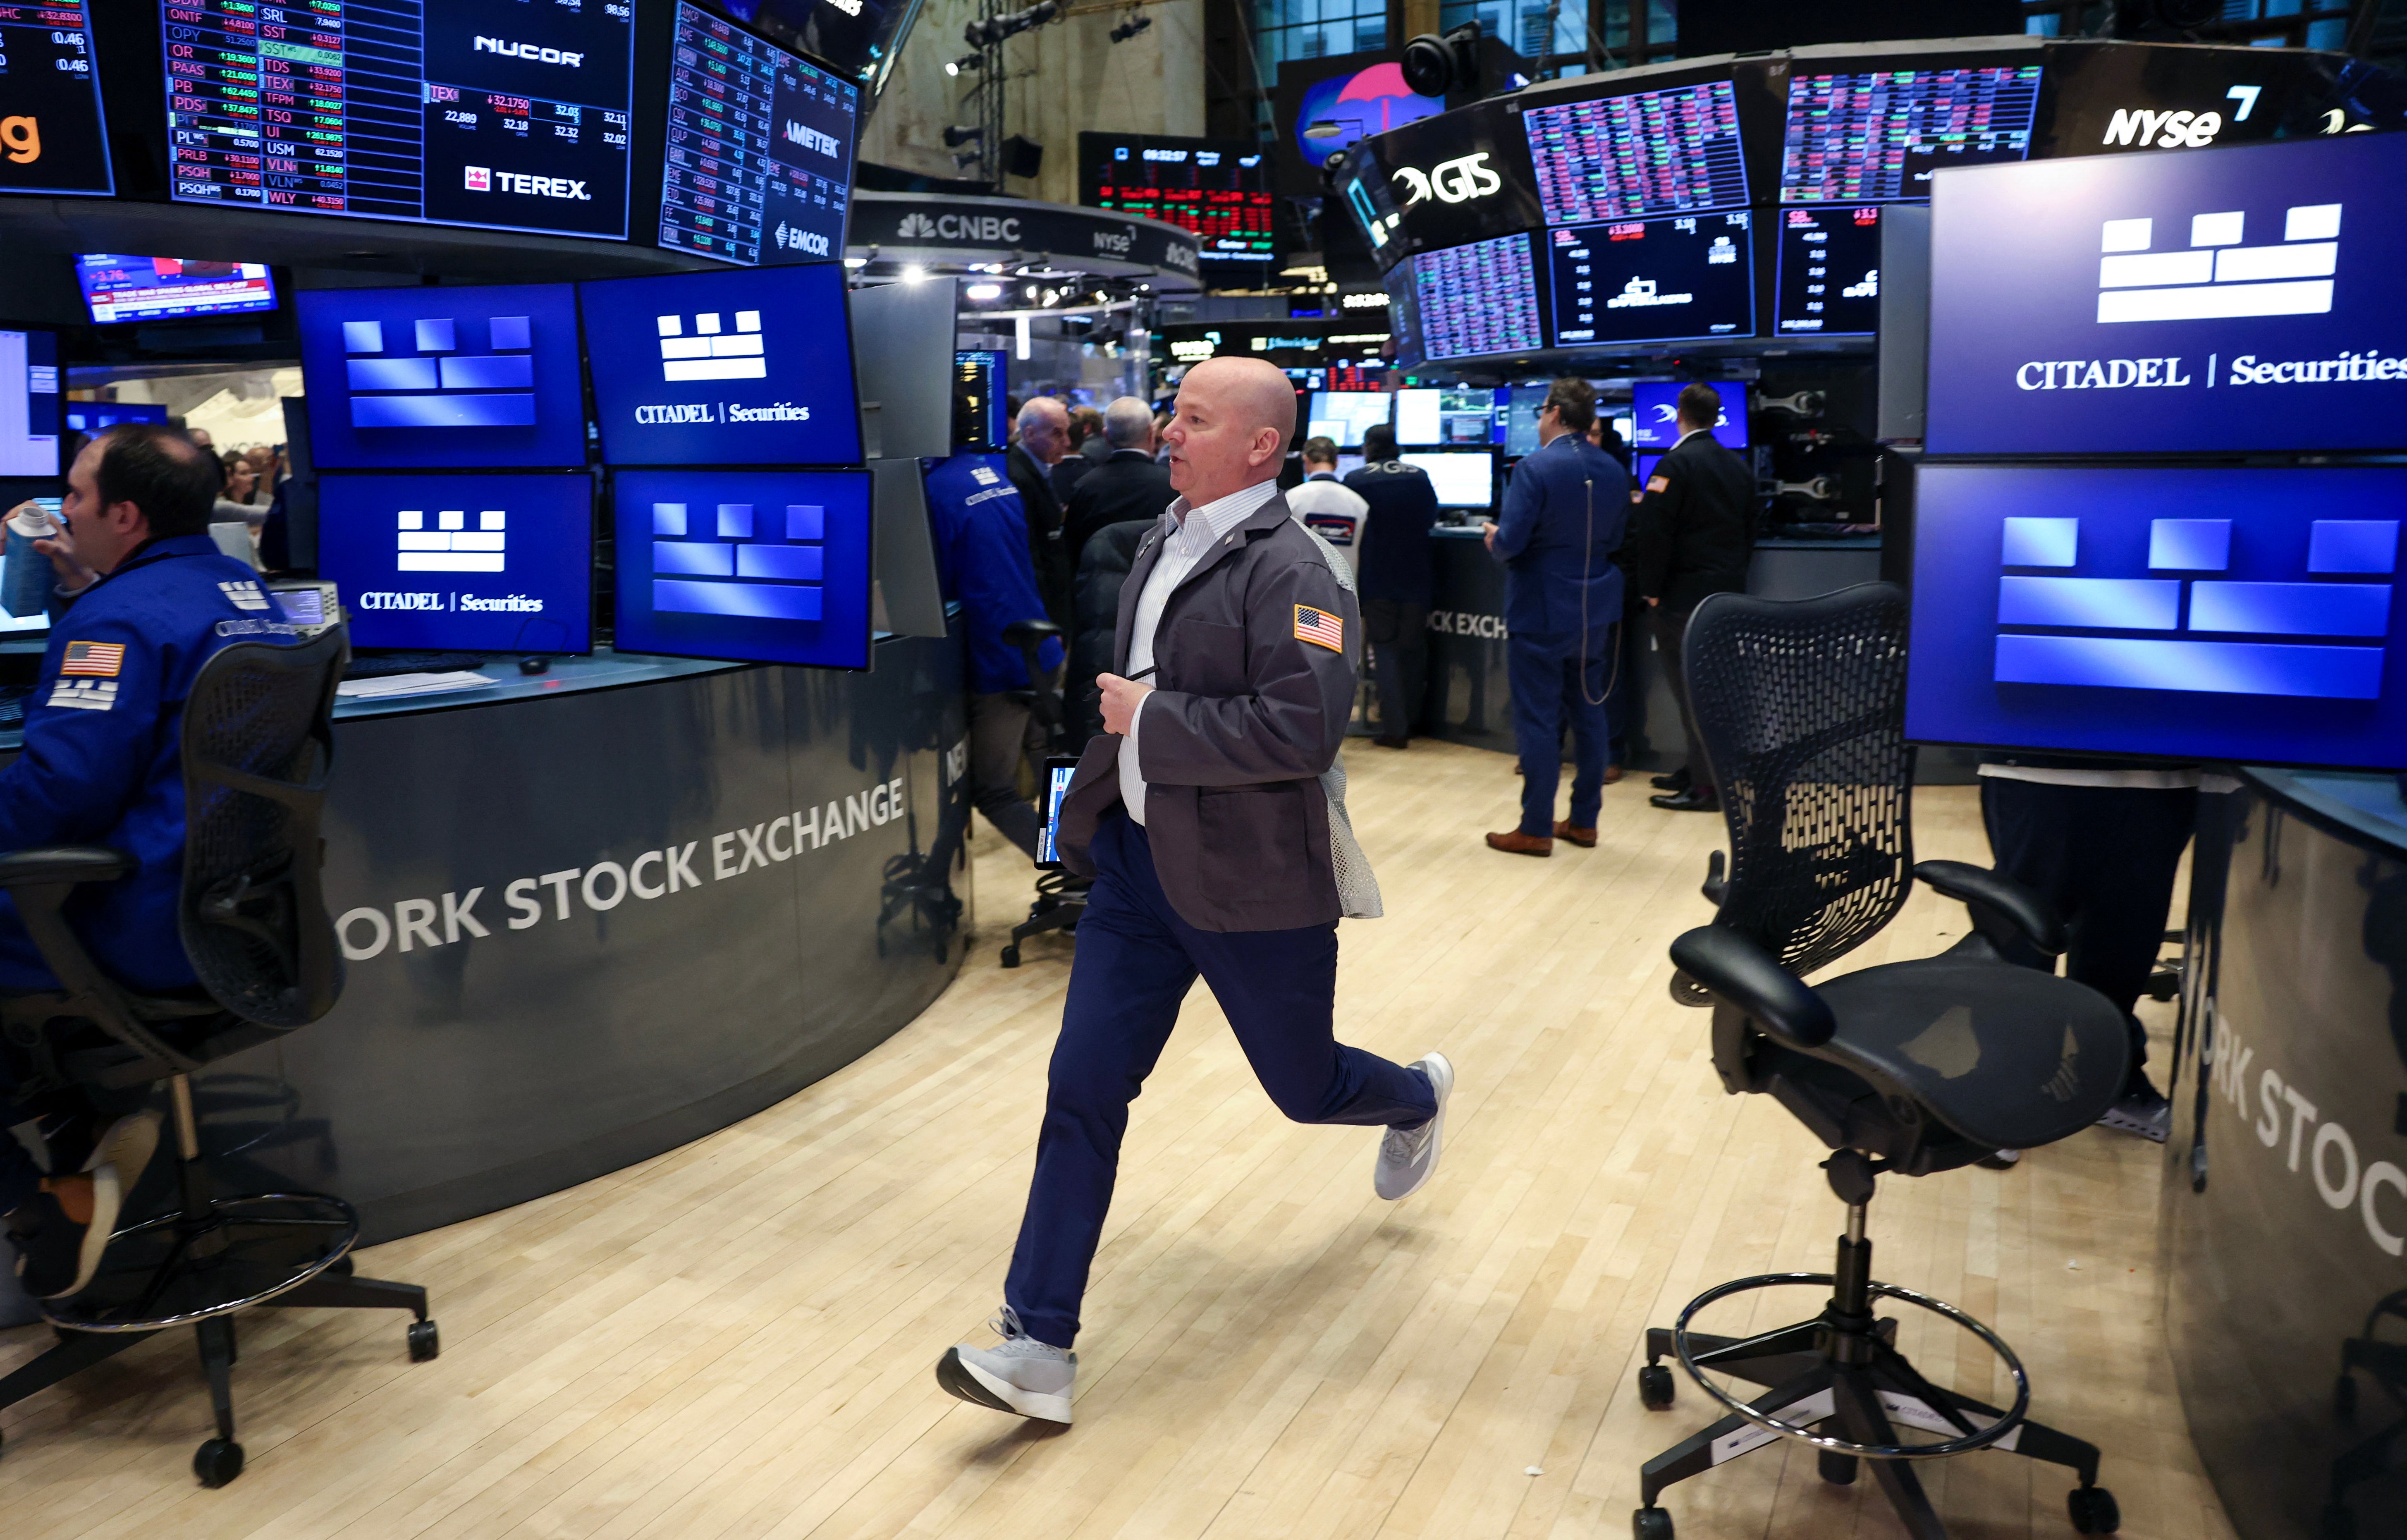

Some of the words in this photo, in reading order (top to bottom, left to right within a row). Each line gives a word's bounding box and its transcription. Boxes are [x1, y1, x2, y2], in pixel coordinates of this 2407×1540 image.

[169, 9, 202, 22] ONTF
[261, 8, 287, 23] SRL
[52, 32, 84, 45] 0.46
[172, 27, 201, 41] OPY
[262, 25, 287, 39] SST
[317, 34, 341, 44] 0.3127
[171, 45, 193, 58] OR
[474, 36, 581, 67] NUCOR
[56, 59, 88, 72] 0.46
[173, 62, 204, 75] PAAS
[265, 59, 289, 73] TDS
[314, 67, 342, 77] 33.9200
[174, 79, 193, 92] PB
[265, 75, 289, 90] TEX
[314, 83, 342, 93] 32.1750
[175, 97, 202, 111] PDS
[265, 93, 294, 105] TFPM
[430, 85, 454, 100] TEX
[494, 95, 529, 109] 32.1750
[555, 105, 579, 117] 32.03
[604, 112, 626, 124] 32.11
[266, 109, 291, 123] TSQ
[267, 126, 280, 138] UI
[445, 110, 477, 124] 22,889
[504, 118, 528, 131] 32.18
[555, 125, 578, 138] 32.32
[603, 132, 626, 144] 32.02
[0, 115, 41, 163] g
[233, 139, 259, 148] 0.5700
[786, 119, 839, 158] AMETEK
[178, 148, 207, 161] PRLB
[268, 142, 294, 156] USM
[316, 148, 343, 158] 62.1520
[178, 166, 210, 178] PSQH
[267, 159, 293, 172] VLN
[235, 188, 261, 197] 0.1700
[496, 172, 587, 200] TEREX
[269, 191, 296, 204] WLY
[937, 217, 1021, 242] CNBC
[789, 228, 828, 256] EMCOR
[2016, 357, 2191, 391] CITADEL
[2230, 349, 2407, 386] Securities
[635, 404, 714, 424] CITADEL
[729, 402, 810, 422] Securities
[360, 592, 444, 610] CITADEL
[460, 594, 543, 612] Securities
[1457, 613, 1508, 639] EXCH
[335, 887, 491, 961] ORK
[504, 841, 701, 930] STOCK
[712, 778, 904, 881] EXCHANGE
[2256, 1069, 2407, 1256] STOC
